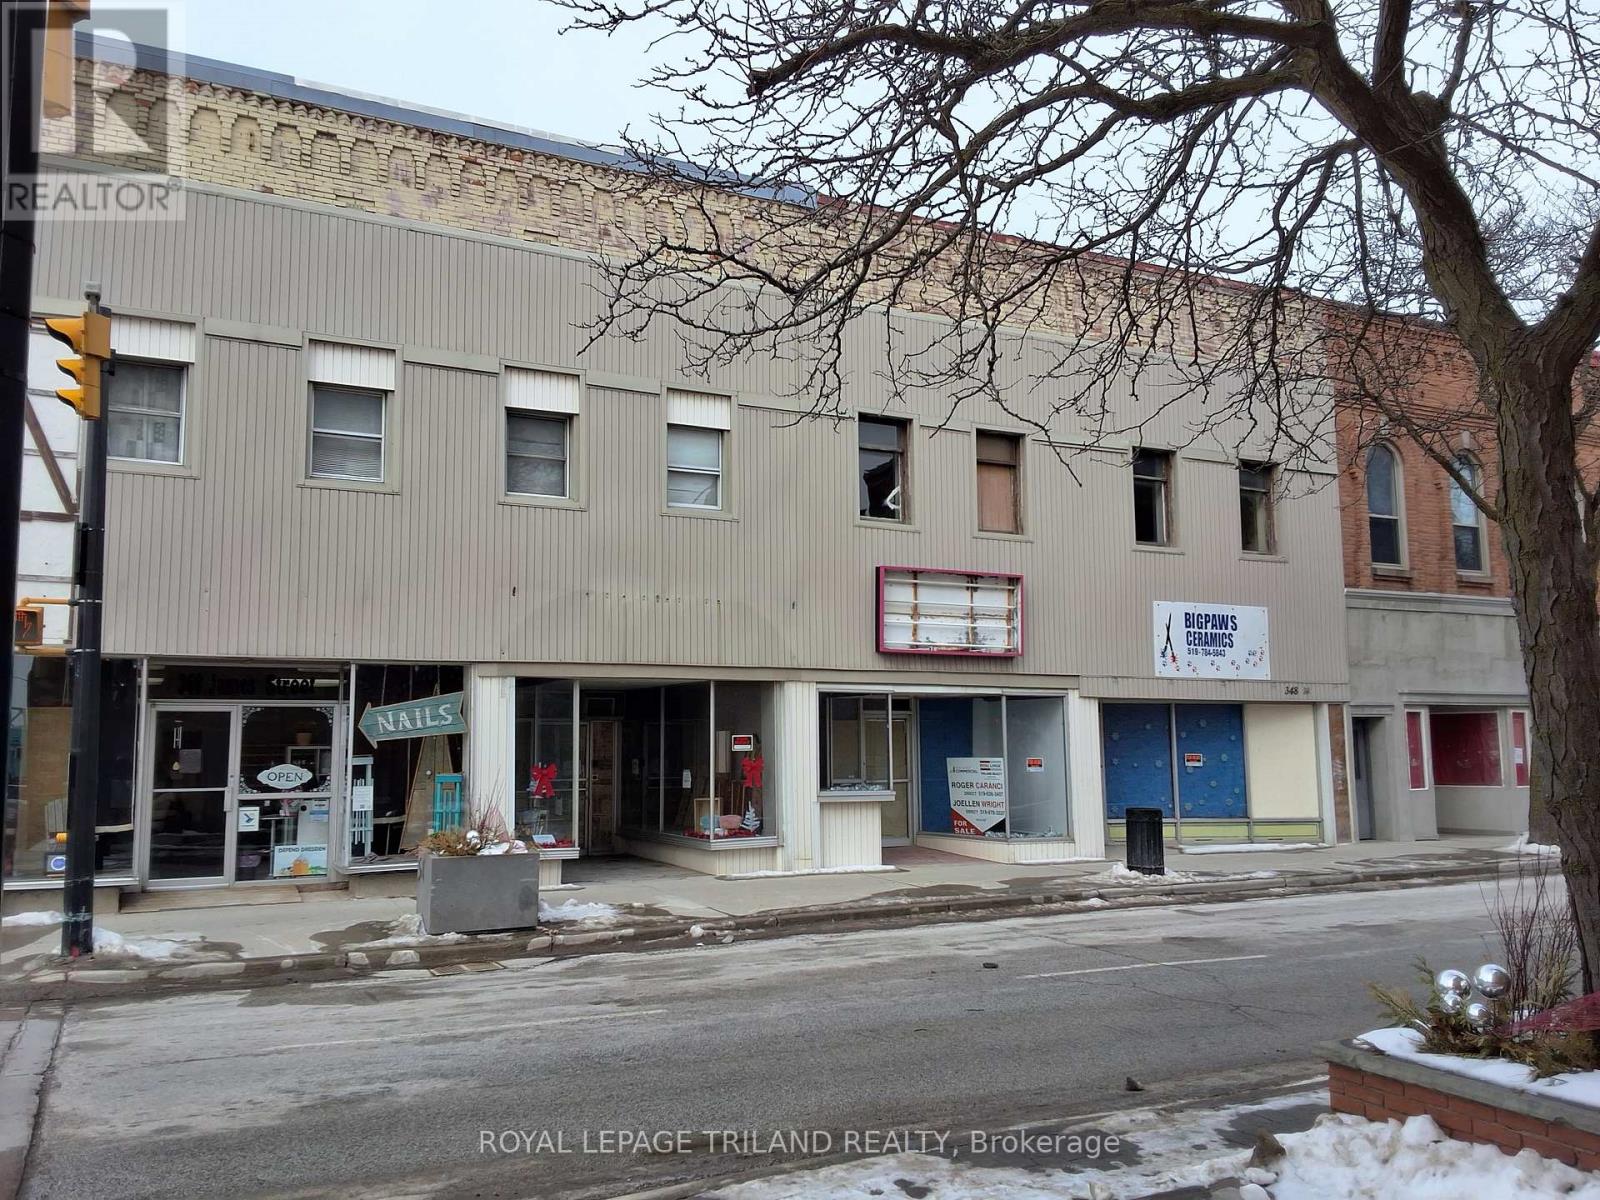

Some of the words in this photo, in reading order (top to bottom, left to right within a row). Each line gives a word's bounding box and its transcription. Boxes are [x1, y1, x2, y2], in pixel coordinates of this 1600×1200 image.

[1184, 612, 1238, 631] BIGPAWS
[1186, 630, 1234, 648] CERAMICS
[376, 703, 453, 733] NAILS
[267, 771, 304, 782] OPEN
[951, 781, 974, 789] ROGER
[953, 799, 980, 808] JOELLEN
[981, 801, 1005, 809] WRIGHT
